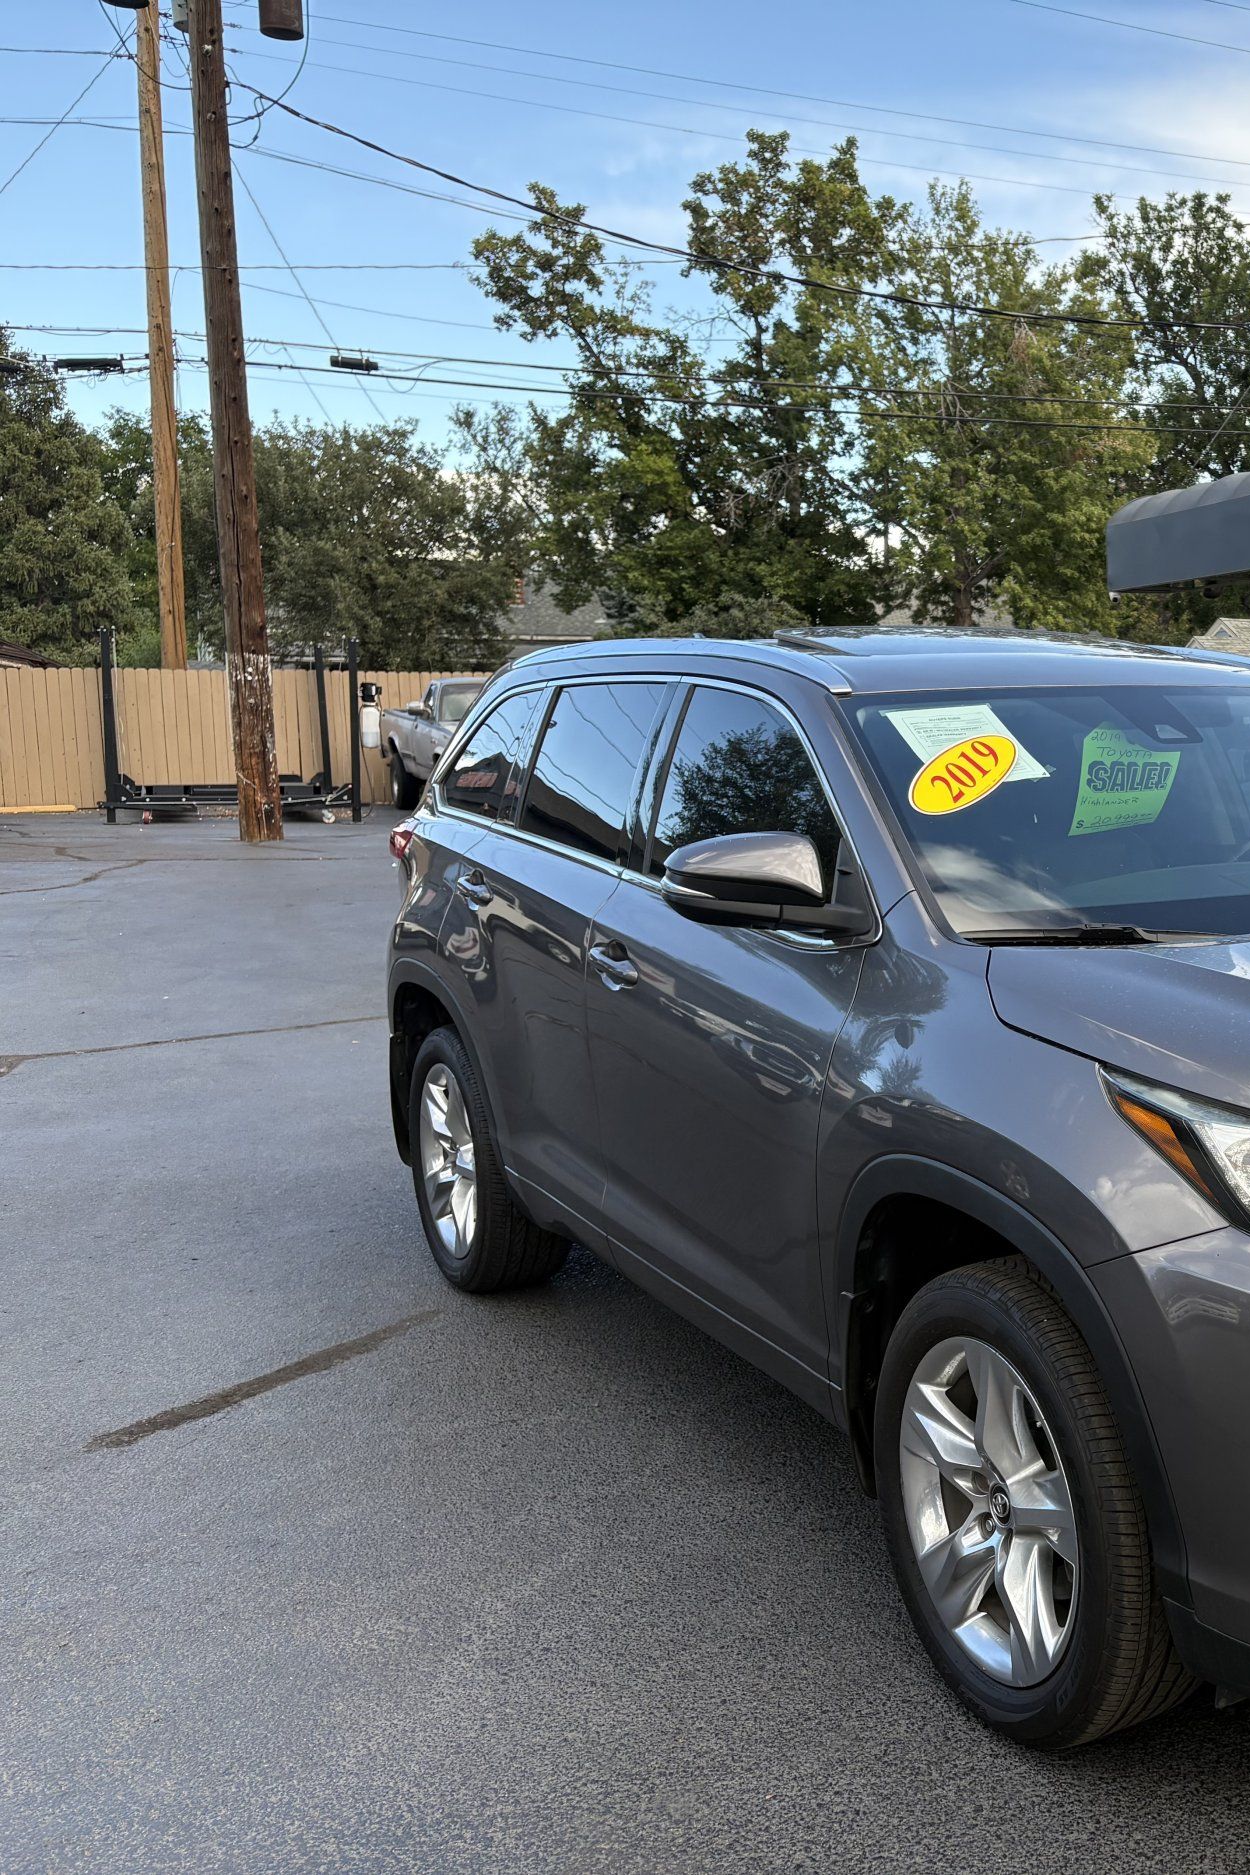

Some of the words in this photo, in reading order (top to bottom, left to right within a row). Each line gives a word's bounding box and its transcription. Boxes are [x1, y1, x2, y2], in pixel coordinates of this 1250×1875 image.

[1091, 731, 1121, 742] 2019
[931, 741, 999, 804] 2019
[1086, 760, 1173, 793] SALE!
